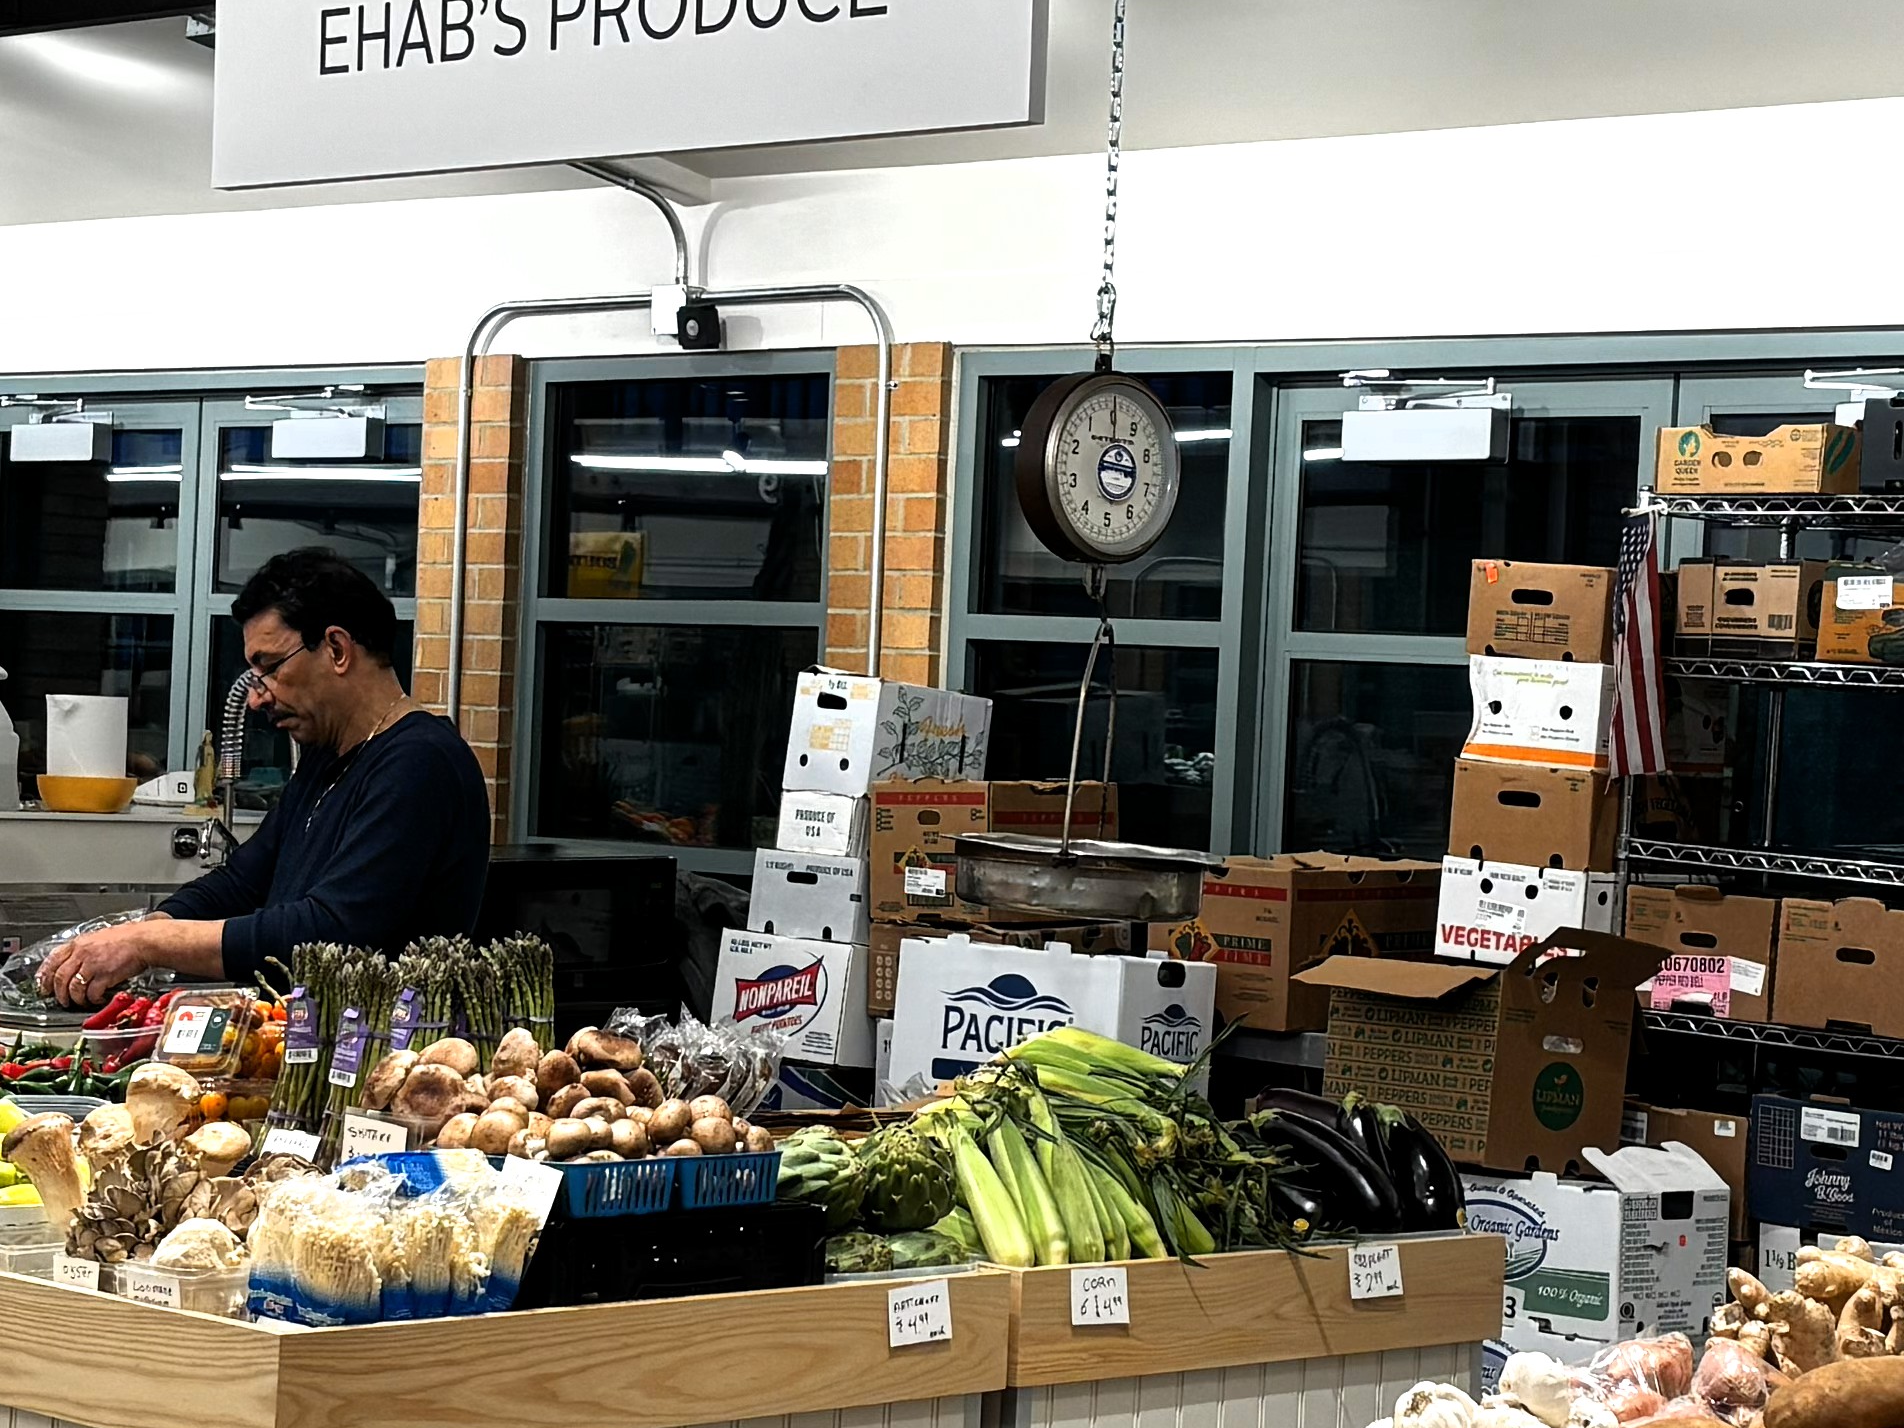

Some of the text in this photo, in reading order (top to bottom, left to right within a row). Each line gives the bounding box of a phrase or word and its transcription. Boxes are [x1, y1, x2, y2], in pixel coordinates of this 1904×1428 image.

[1130, 422, 1137, 437] 9
[1071, 439, 1080, 455] 2
[1143, 448, 1151, 463] 8
[1069, 472, 1077, 488] 3
[1143, 483, 1150, 497] 7
[1081, 500, 1089, 515] 4
[1126, 504, 1134, 520] 6
[1103, 512, 1111, 528] 5
[1222, 936, 1265, 949] PRIME
[738, 973, 813, 1012] NONPAREIL
[1140, 1025, 1198, 1056] PACIFIC
[1363, 1046, 1413, 1064] PEPPERS
[1377, 1086, 1427, 1104] PEPPERS
[1421, 1112, 1473, 1130] PEPPERS
[1804, 1167, 1851, 1189] Johnny
[1515, 1220, 1560, 1242] Gardens
[1569, 1290, 1603, 1308] Organic
